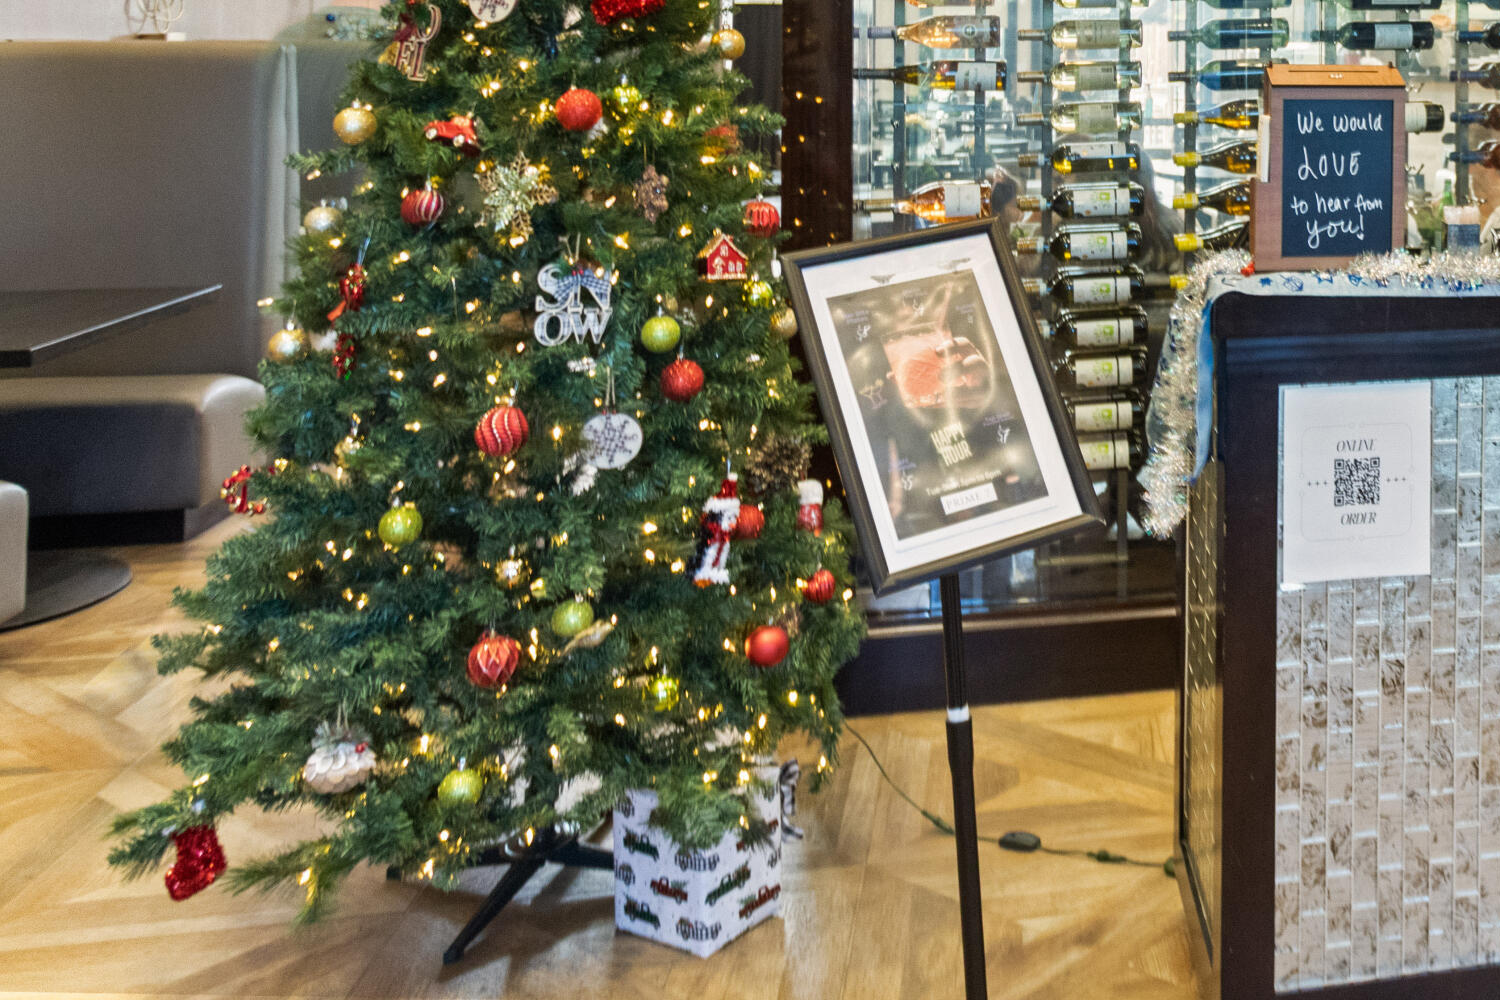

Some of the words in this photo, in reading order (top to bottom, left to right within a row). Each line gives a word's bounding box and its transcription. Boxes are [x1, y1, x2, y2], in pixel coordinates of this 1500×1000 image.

[1297, 111, 1324, 134] We
[1333, 112, 1384, 133] would
[1297, 146, 1362, 181] LOVE
[1290, 195, 1308, 216] to
[1315, 192, 1351, 214] hear
[1354, 193, 1383, 214] from
[1306, 214, 1366, 249] you!
[930, 421, 966, 452] HAPPY
[1336, 438, 1377, 452] ONLINE
[939, 440, 973, 467] HOUR
[1340, 511, 1377, 526] ORDER
